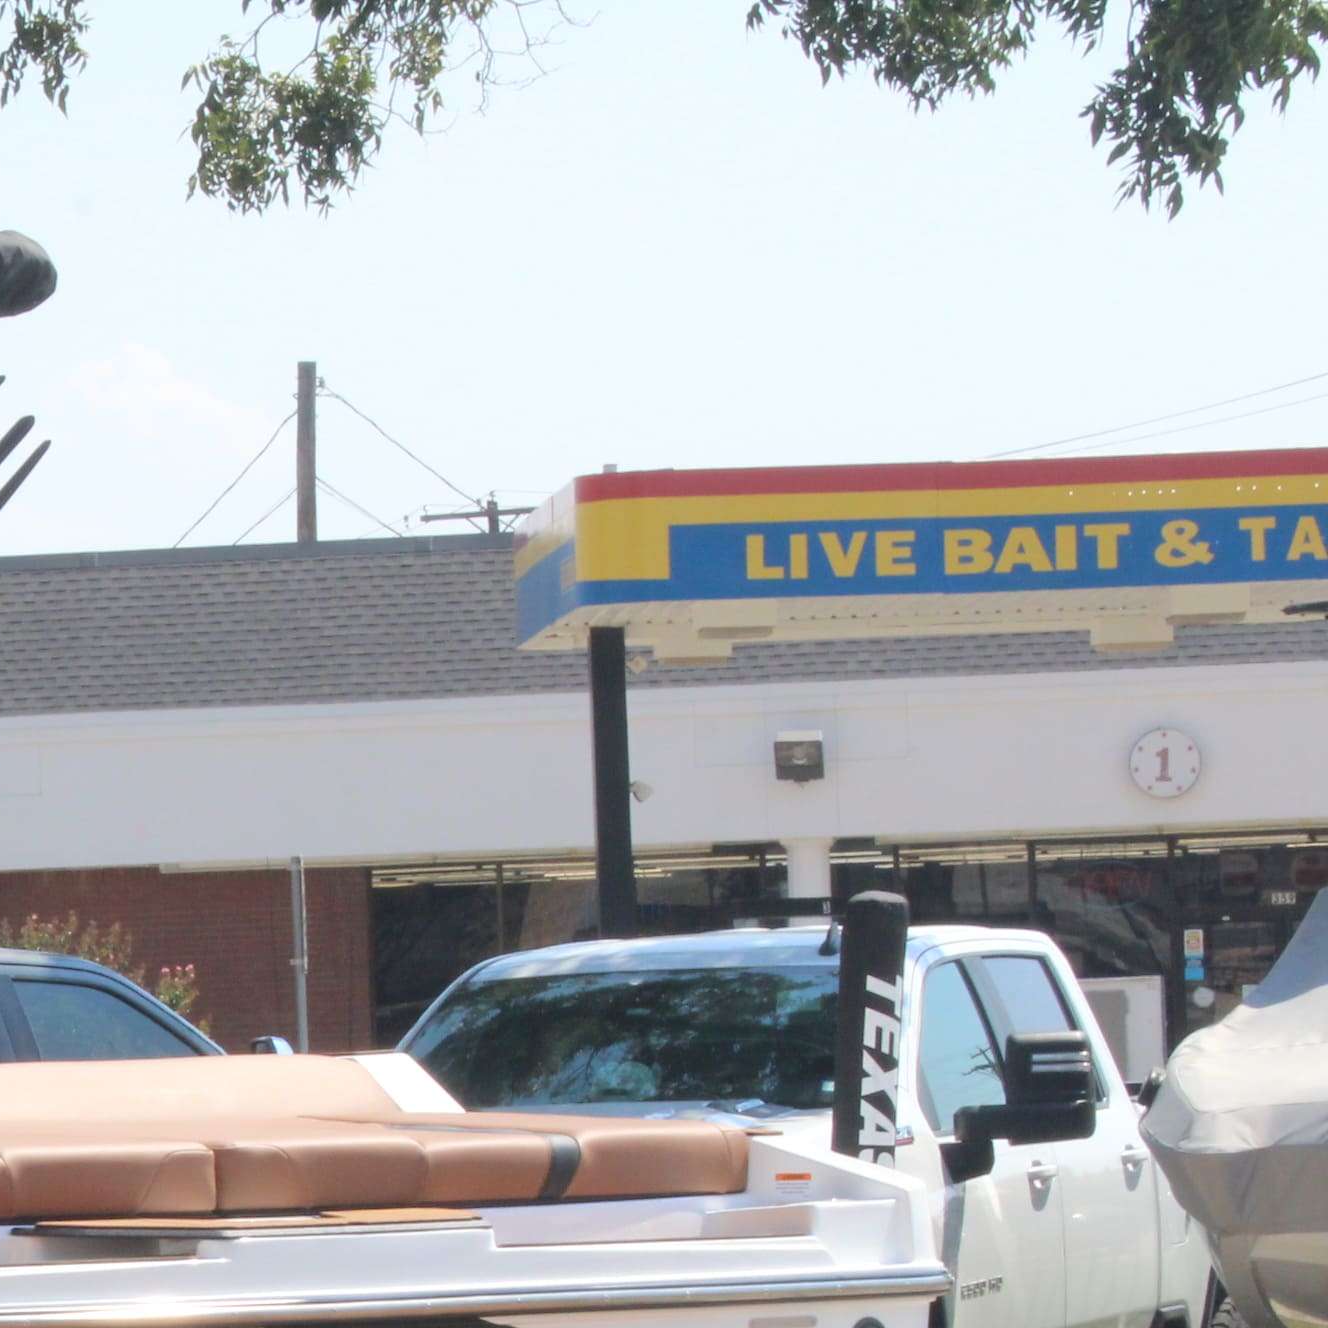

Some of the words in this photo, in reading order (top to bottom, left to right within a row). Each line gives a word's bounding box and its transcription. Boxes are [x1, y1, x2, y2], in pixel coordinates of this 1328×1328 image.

[746, 530, 917, 580] LIVE
[945, 523, 1131, 576] BAIT
[1154, 519, 1214, 568] &
[1154, 746, 1173, 782] 1
